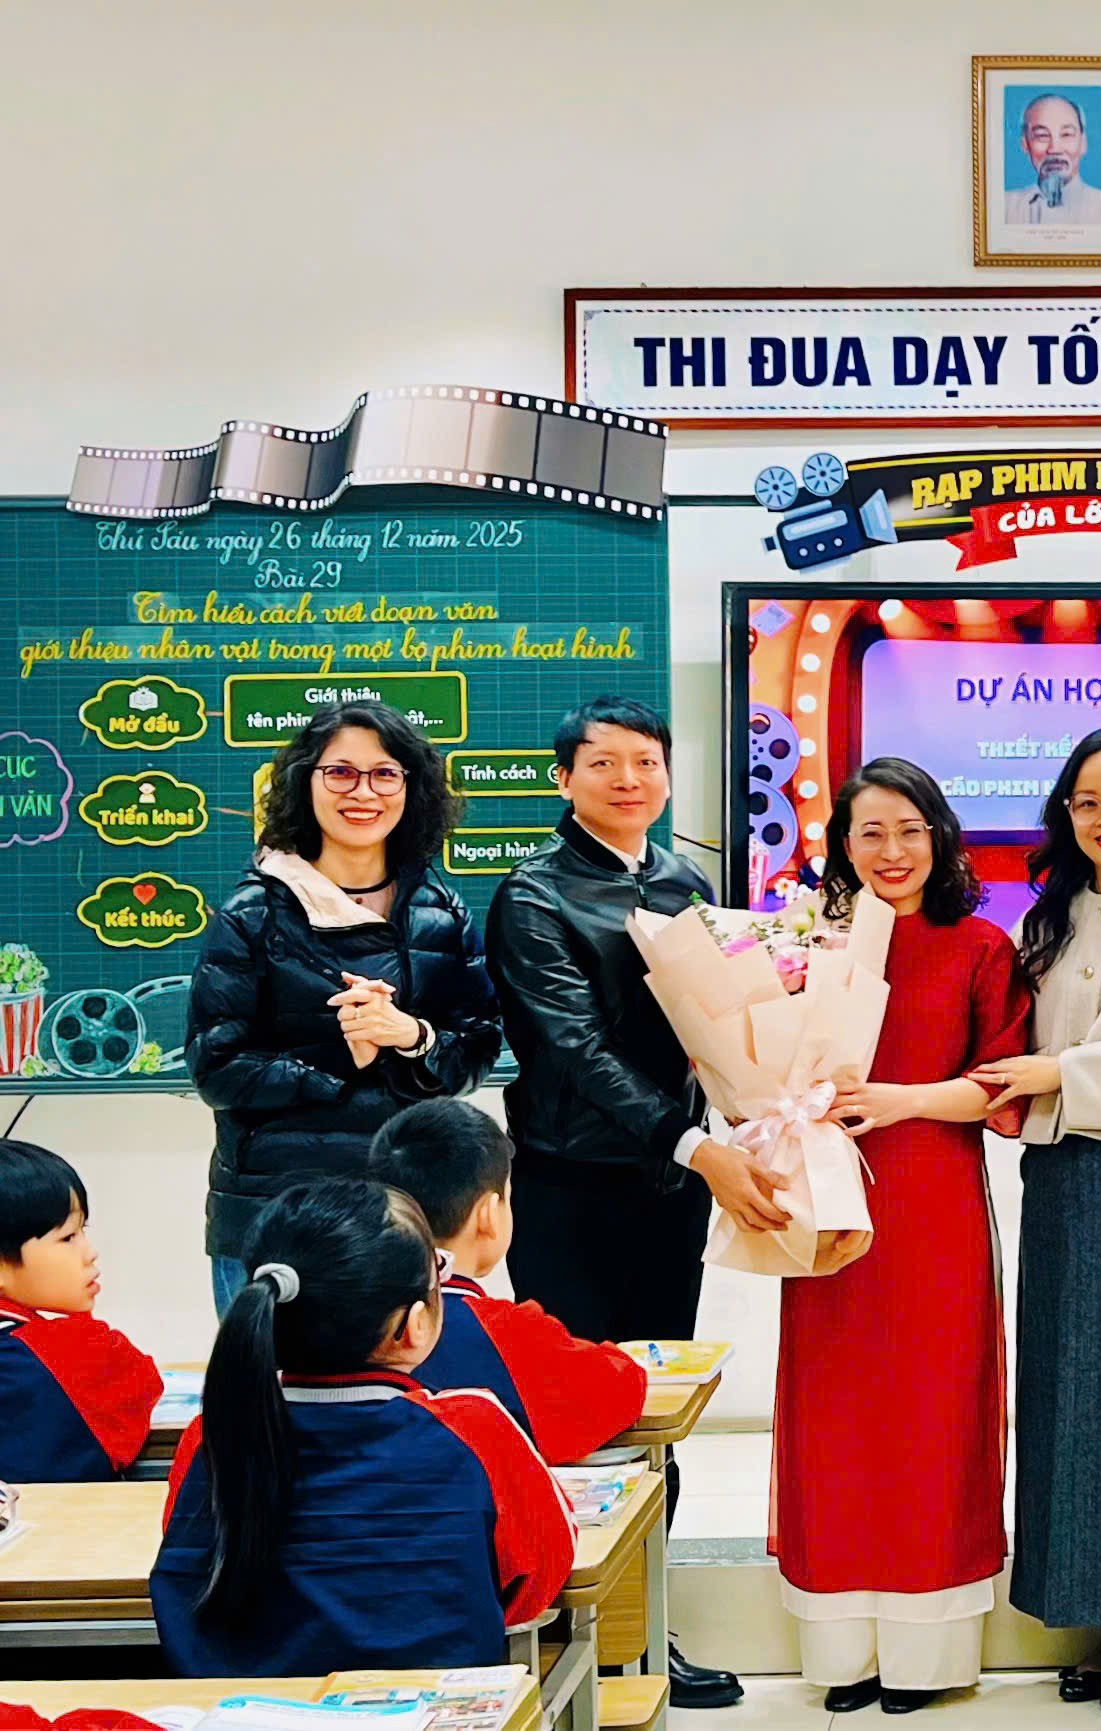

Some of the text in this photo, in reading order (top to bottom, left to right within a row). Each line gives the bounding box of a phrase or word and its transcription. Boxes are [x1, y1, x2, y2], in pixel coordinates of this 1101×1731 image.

[634, 337, 726, 387] THI
[748, 337, 872, 387] ĐUA
[893, 335, 1008, 398] DẠY
[911, 469, 983, 510] RẠP
[991, 461, 1087, 495] PHIM
[998, 502, 1055, 533] CỦA
[206, 530, 264, 565] ngày
[268, 521, 301, 549] 26
[311, 518, 371, 562] tháng
[381, 519, 403, 548] 12
[406, 528, 460, 548] năm
[466, 520, 527, 547] 2025
[254, 559, 342, 588] Bài 29
[133, 591, 197, 623] Tìm
[260, 592, 317, 623] cách
[444, 602, 498, 621] văn
[68, 627, 132, 663] thiệu
[138, 626, 214, 659] nhân
[220, 640, 260, 663] vật
[268, 640, 335, 673] trong
[343, 638, 393, 662] một
[400, 627, 428, 662] bộ
[429, 627, 505, 672] phim
[512, 625, 567, 660] hoạt
[571, 627, 635, 659] hình
[304, 688, 337, 704] Giới
[956, 677, 1003, 707] DỰ
[1011, 671, 1053, 702] ÁN
[109, 714, 140, 733] Mở
[246, 711, 273, 728] tên
[977, 733, 1040, 758] THIẾT
[461, 764, 537, 780] Tính cách
[940, 775, 980, 796] CÁO
[984, 780, 1039, 796] PHIM
[10, 789, 52, 817] VĂN
[99, 804, 195, 825] Triển khai
[453, 842, 502, 861] Ngoại
[104, 906, 186, 927] Kết thúc
